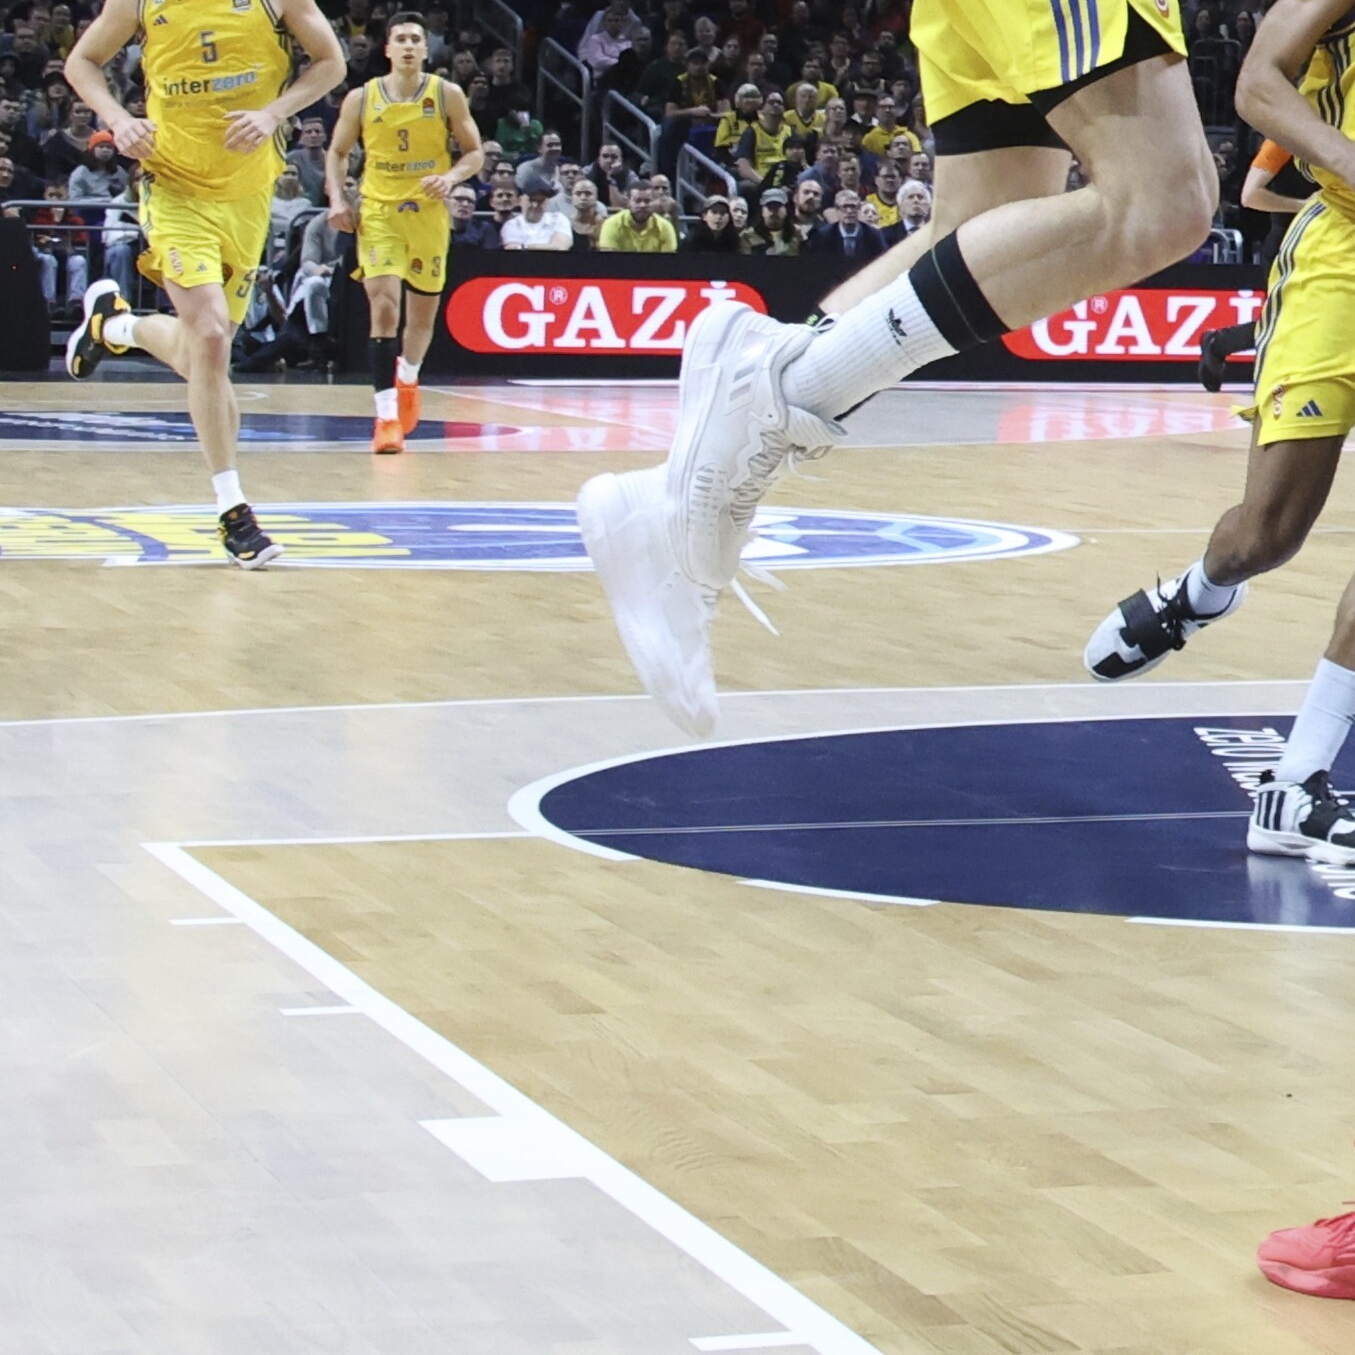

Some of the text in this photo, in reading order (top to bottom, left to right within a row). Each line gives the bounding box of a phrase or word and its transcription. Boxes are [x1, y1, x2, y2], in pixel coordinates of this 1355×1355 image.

[200, 30, 219, 64] 5
[163, 71, 258, 97] interzero
[397, 129, 410, 152] 3
